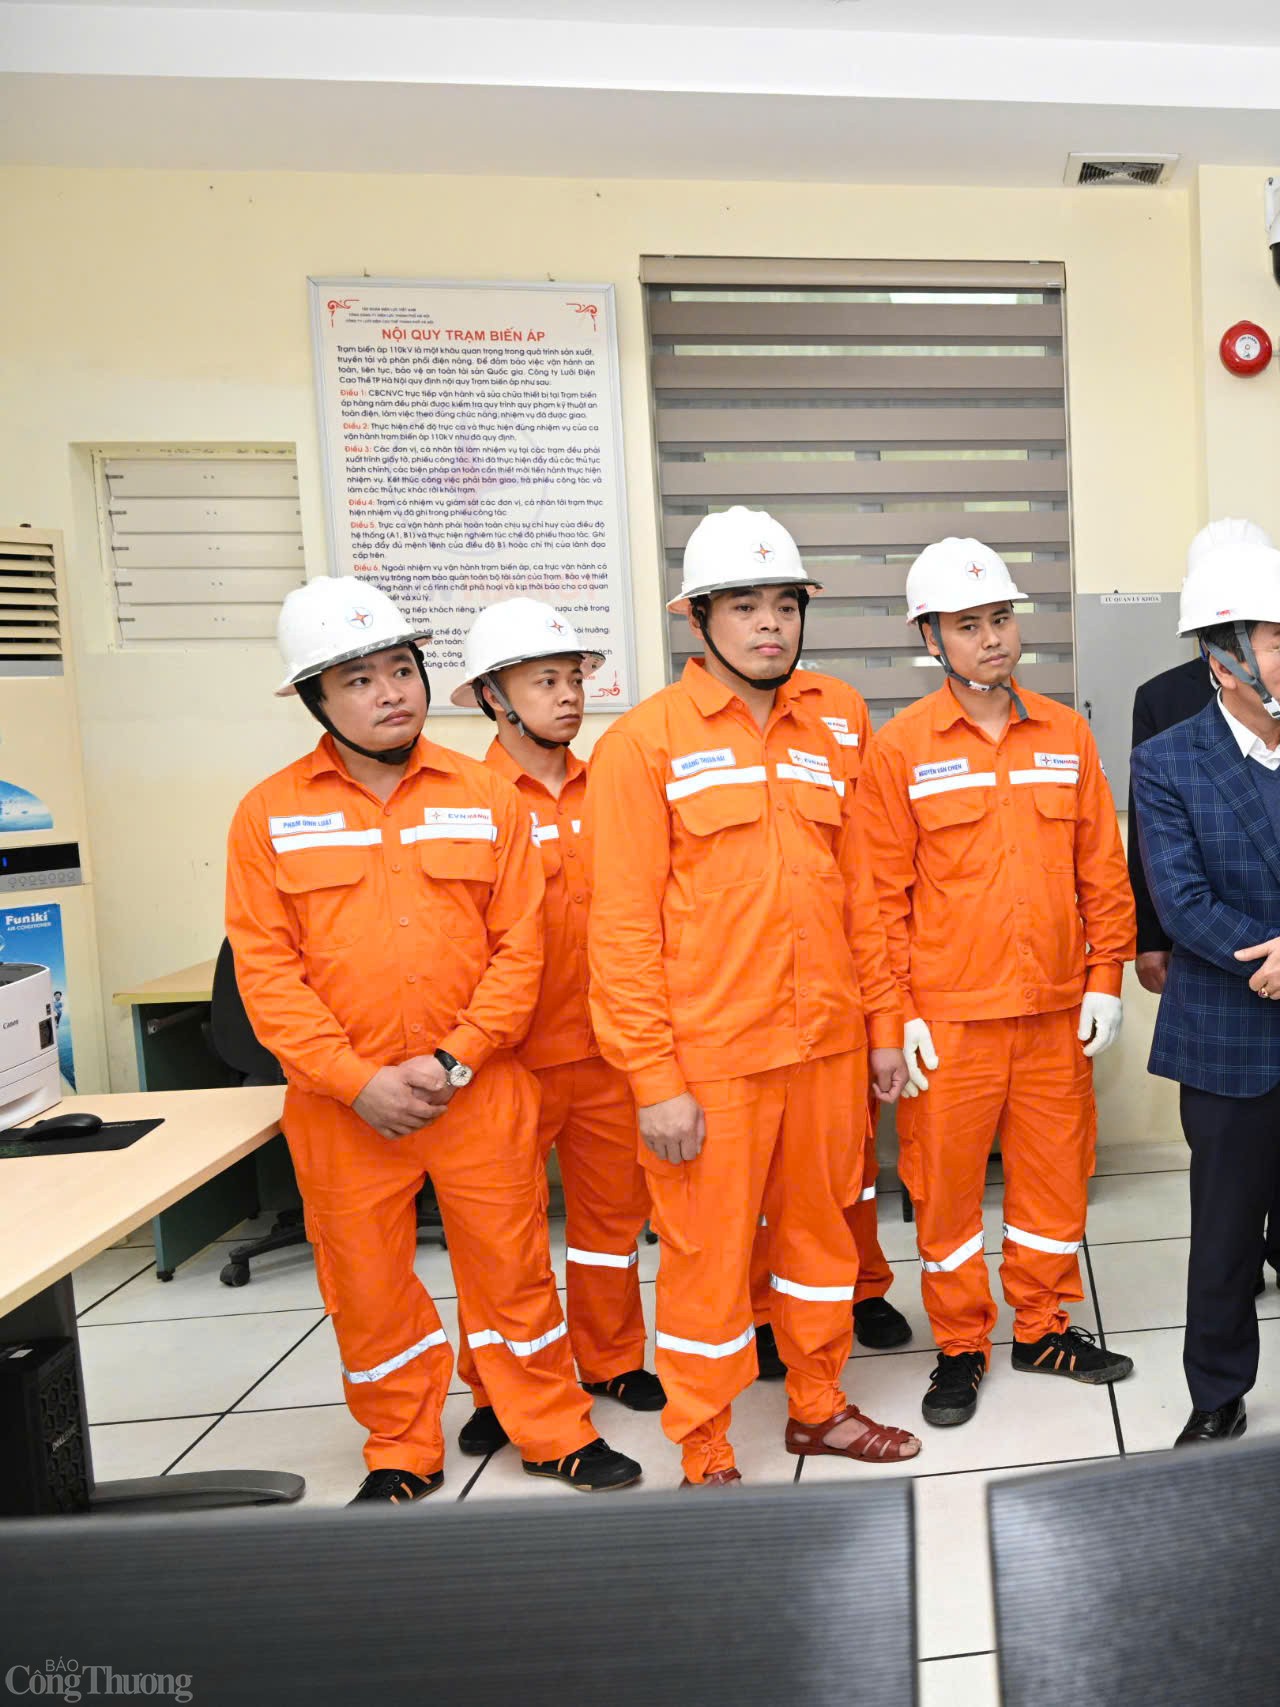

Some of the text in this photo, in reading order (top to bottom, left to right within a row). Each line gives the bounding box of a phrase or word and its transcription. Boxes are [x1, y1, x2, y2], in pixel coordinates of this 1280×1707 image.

[382, 326, 546, 344] NỘI QUY TRẠM BIẾN ÁP
[337, 345, 357, 354] Trạm
[357, 345, 376, 353] biến
[376, 346, 388, 355] áp
[390, 346, 413, 354] 110kV
[413, 346, 422, 354] là
[422, 346, 439, 355] một
[439, 346, 460, 354] khâu
[461, 348, 482, 356] quan
[482, 347, 504, 357] trọng
[504, 347, 526, 357] trong
[525, 347, 542, 357] quá
[560, 348, 574, 356] sản
[337, 356, 363, 365] truyền
[364, 355, 376, 363] tải
[377, 356, 388, 364] và
[388, 356, 411, 365] phân
[411, 356, 430, 366] phối
[431, 357, 450, 366] điện
[476, 357, 489, 365] Để
[489, 357, 509, 365] đảm
[527, 358, 545, 367] việc
[546, 358, 562, 367] vận
[562, 358, 583, 366] hành
[360, 366, 376, 374] liên
[413, 367, 424, 376] vệ
[437, 367, 457, 375] toàn
[458, 367, 469, 375] tài
[527, 368, 550, 377] Công
[550, 368, 559, 377] ty
[577, 369, 596, 378] Điện
[338, 376, 357, 384] Cao
[357, 376, 372, 384] Thế
[372, 376, 381, 384] TP
[393, 377, 408, 386] Nội
[407, 378, 423, 386] quy
[423, 377, 442, 386] định
[441, 377, 455, 386] nội
[471, 378, 490, 387] Trạm
[508, 378, 520, 387] áp
[367, 389, 404, 397] CBCNVC
[404, 390, 421, 399] trực
[421, 390, 438, 399] tiếp
[438, 390, 454, 399] vận
[454, 390, 475, 398] hành
[475, 390, 486, 398] và
[501, 390, 523, 398] chữa
[540, 391, 549, 400] bị
[549, 391, 560, 400] tại
[560, 391, 579, 400] Trạm
[579, 391, 597, 399] biến
[343, 432, 359, 441] vận
[380, 433, 400, 442] trạm
[418, 433, 430, 442] áp
[470, 433, 482, 441] đã
[380, 485, 394, 493] thủ
[393, 486, 407, 495] tục
[376, 498, 396, 507] Trạm
[396, 498, 408, 506] có
[408, 498, 434, 507] nhiệm
[445, 498, 467, 508] giám
[467, 498, 480, 506] sát
[480, 498, 496, 506] các
[497, 498, 513, 506] đơn
[567, 499, 586, 507] trạm
[586, 499, 603, 507] thực
[381, 564, 406, 573] Ngoài
[406, 564, 432, 573] nhiệm
[443, 564, 459, 572] vận
[459, 563, 480, 571] hành
[480, 563, 500, 572] trạm
[500, 563, 518, 571] biến
[544, 563, 559, 572] trực
[561, 563, 576, 572] vận
[6, 911, 48, 926] Funiki
[3, 1019, 19, 1030] Canon
